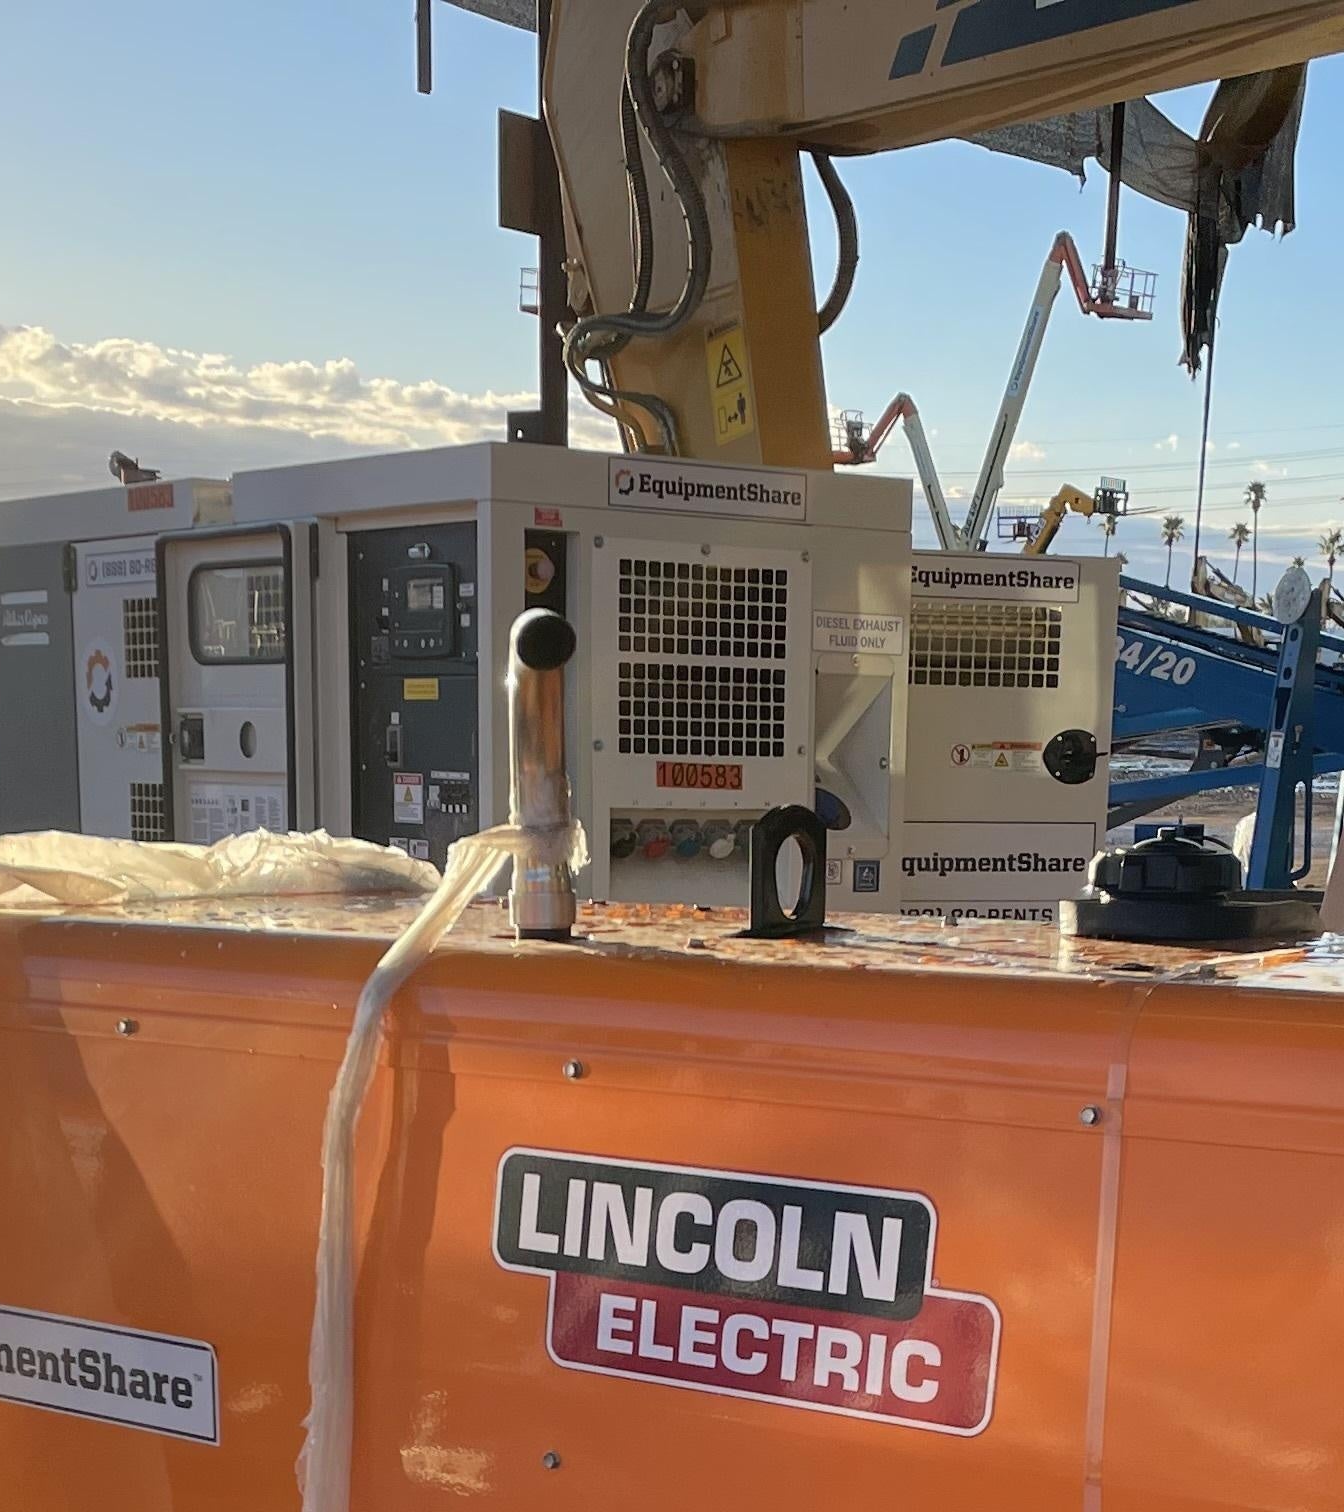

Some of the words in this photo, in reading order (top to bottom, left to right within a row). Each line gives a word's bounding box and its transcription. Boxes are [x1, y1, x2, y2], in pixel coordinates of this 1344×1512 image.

[639, 474, 801, 506] EquipmentShare
[816, 617, 851, 630] DIESEL
[853, 618, 900, 632] EXHAUST
[829, 636, 858, 648] FLUID
[860, 637, 886, 649] ONLY
[658, 763, 742, 788] 100583
[902, 852, 1086, 877] quipmentShare
[518, 1173, 904, 1302] LINCOLN
[596, 1293, 942, 1403] ELECTRIC
